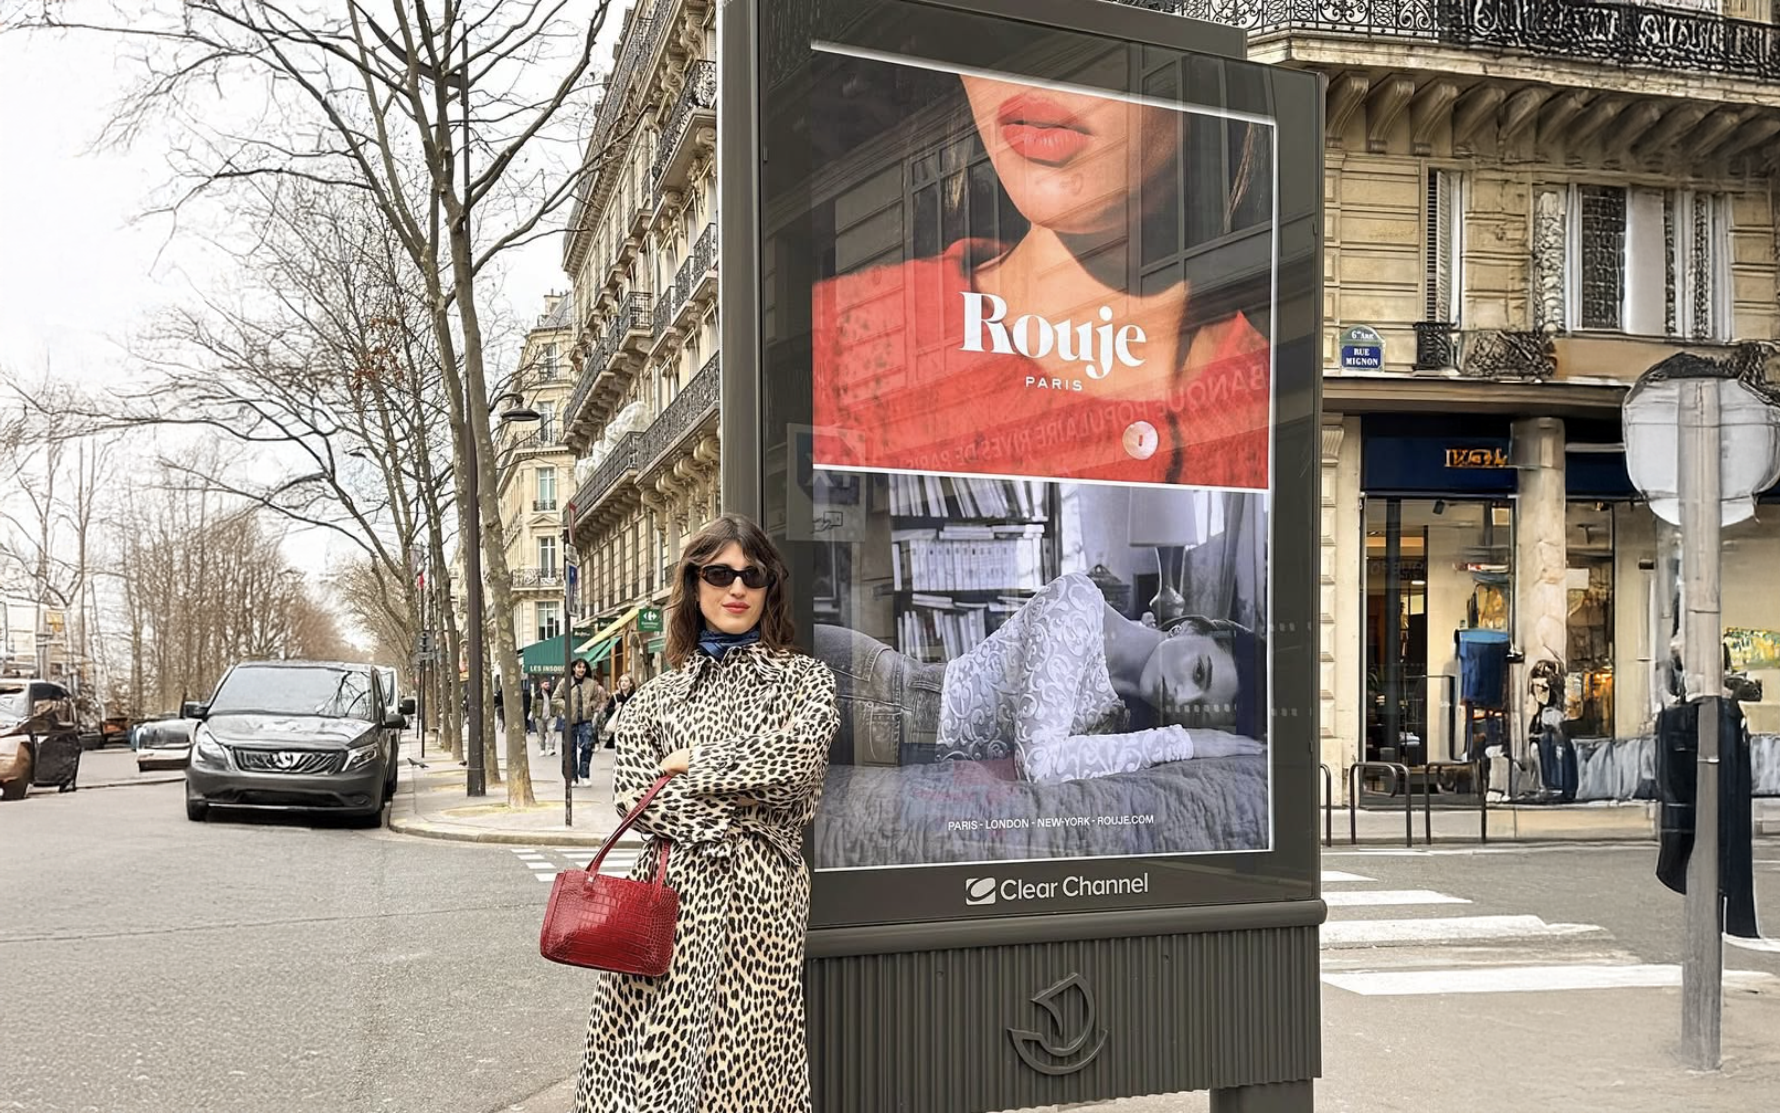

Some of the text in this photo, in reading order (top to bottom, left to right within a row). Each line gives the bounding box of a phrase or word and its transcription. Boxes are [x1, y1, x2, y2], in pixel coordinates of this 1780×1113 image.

[958, 291, 1147, 379] Rouje
[1354, 348, 1370, 356] RUE
[1346, 357, 1378, 366] MIGNON
[1025, 376, 1083, 391] PARIS
[948, 820, 978, 831] PARIS
[985, 818, 1029, 830] LONDON
[1037, 816, 1091, 828] NEW-YORK
[1097, 814, 1154, 826] ROUJE.COM
[1000, 872, 1148, 900] Clear Channel
